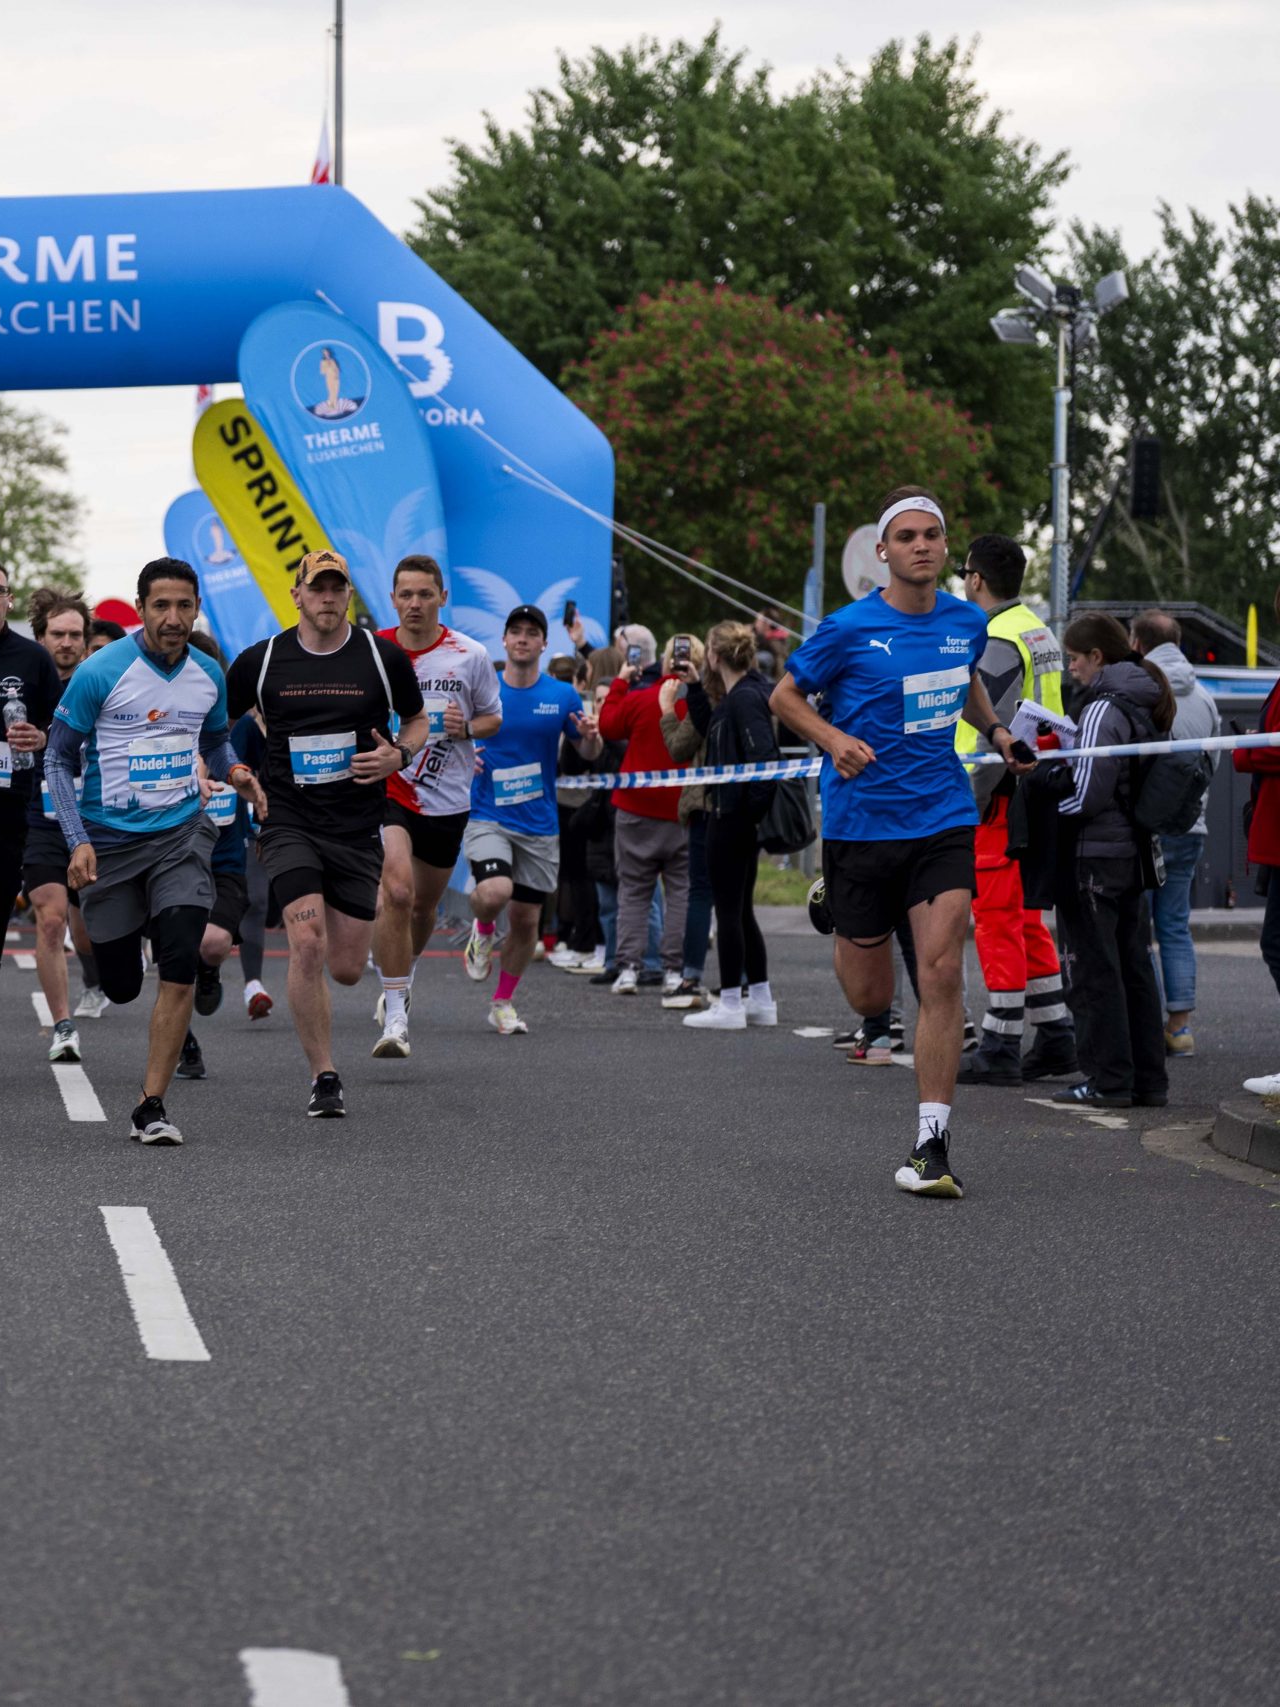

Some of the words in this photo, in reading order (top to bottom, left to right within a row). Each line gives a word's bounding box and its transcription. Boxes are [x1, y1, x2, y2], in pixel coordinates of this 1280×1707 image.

[419, 407, 485, 426] ORIA
[304, 422, 382, 449] THERME
[434, 679, 463, 692] 2025
[113, 713, 134, 721] ARD
[303, 750, 345, 766] Pascal
